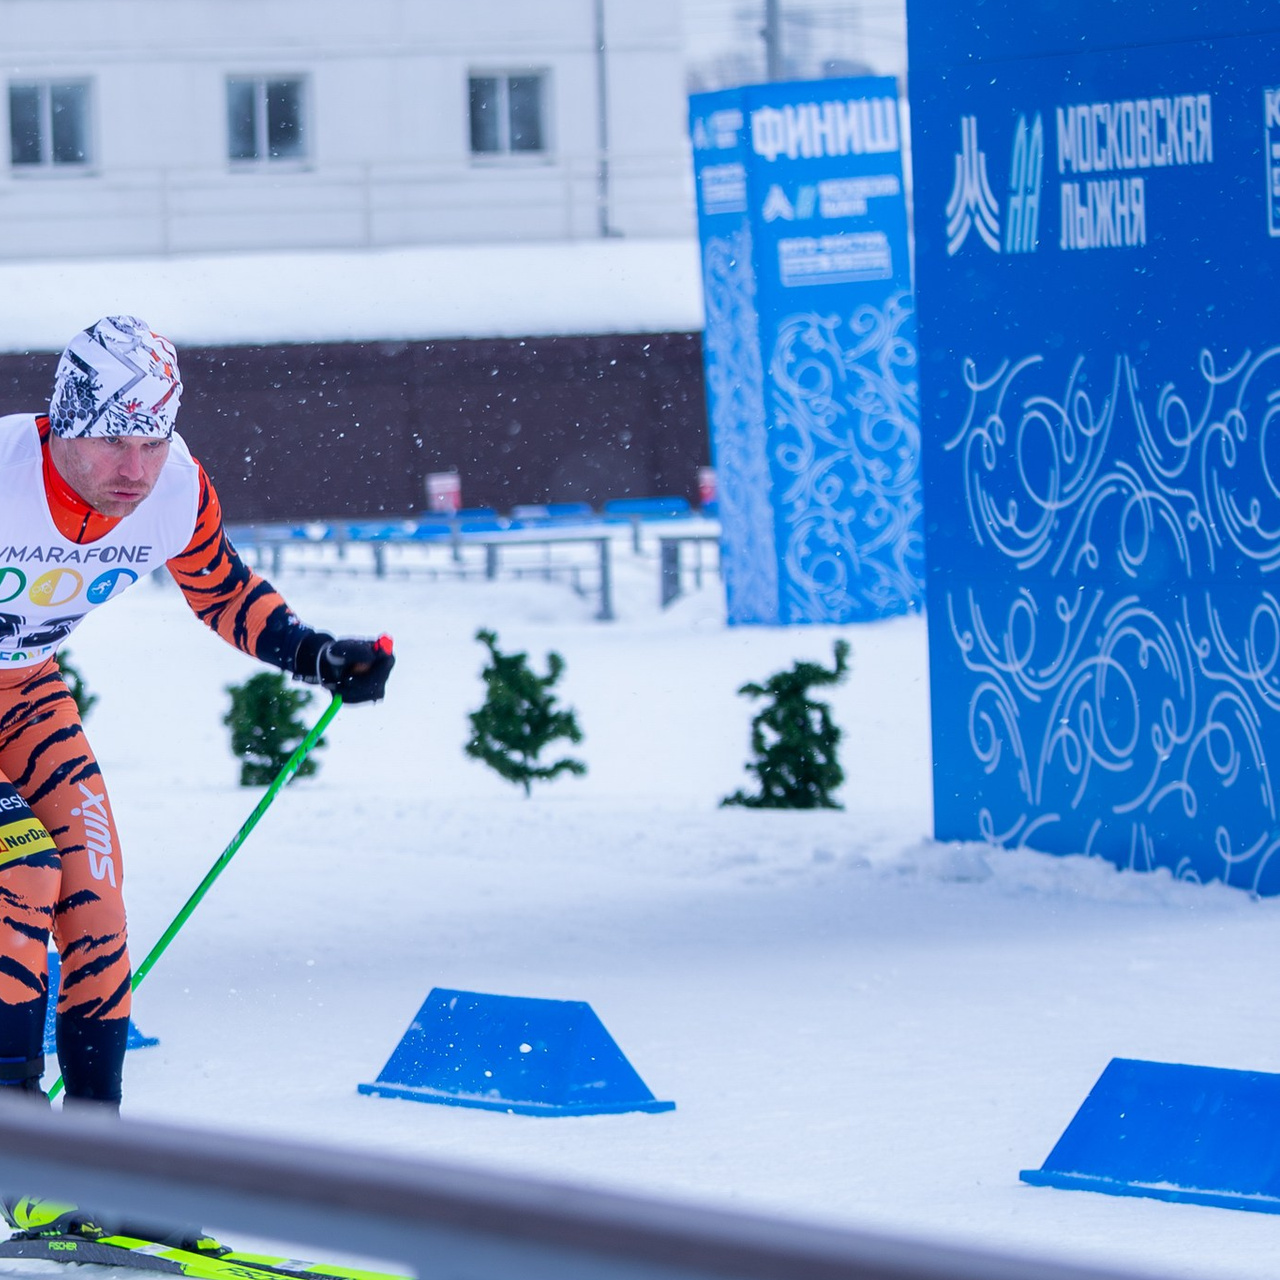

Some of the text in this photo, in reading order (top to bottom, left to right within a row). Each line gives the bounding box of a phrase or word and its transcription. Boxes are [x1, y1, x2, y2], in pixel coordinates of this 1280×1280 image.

[750, 97, 900, 161] ФИНИШ
[1055, 93, 1213, 174] МОСКОВСКАЯ
[1059, 176, 1147, 251] ЛЫЖНЯ
